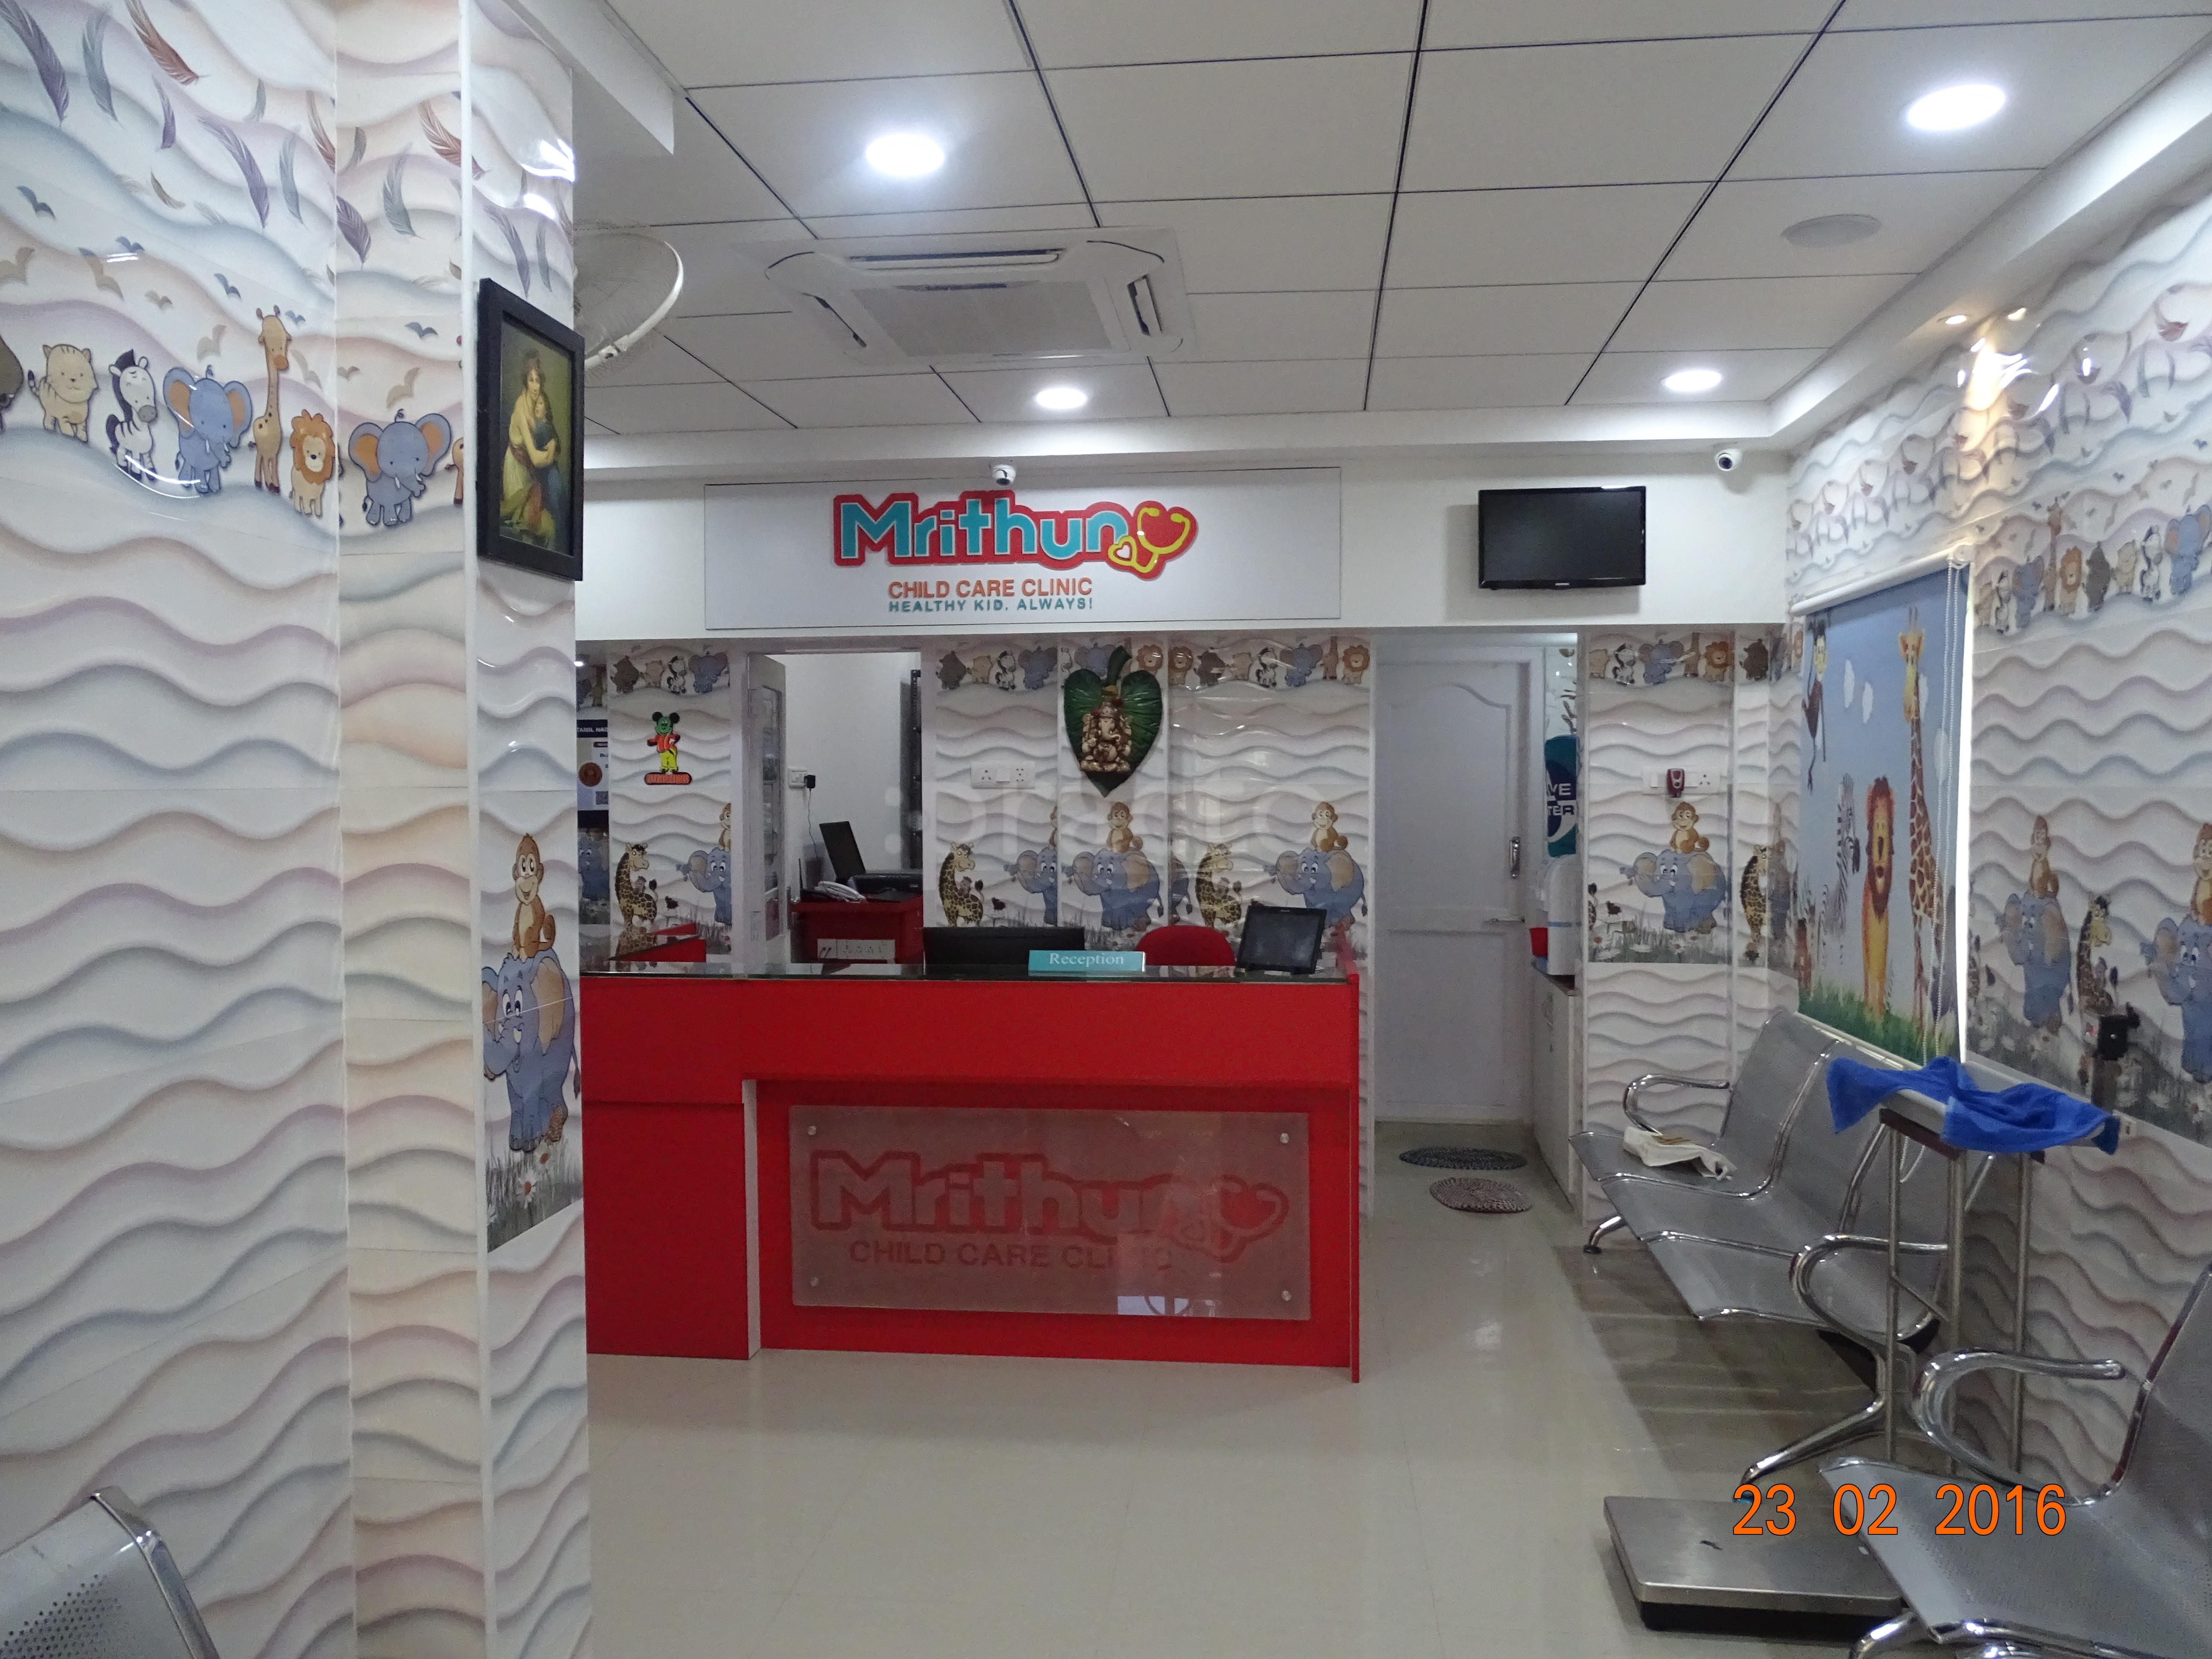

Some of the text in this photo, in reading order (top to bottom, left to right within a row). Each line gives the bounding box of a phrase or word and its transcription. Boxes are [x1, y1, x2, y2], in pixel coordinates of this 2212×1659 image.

[837, 494, 1132, 564] Mrithun
[888, 577, 1093, 599] CHILD CARE CLINIC
[888, 597, 1093, 613] HEALTHY KID. ALWAYS!
[1048, 952, 1124, 967] Reception
[849, 1239, 945, 1266] CHILD
[957, 1242, 1050, 1268] CARE
